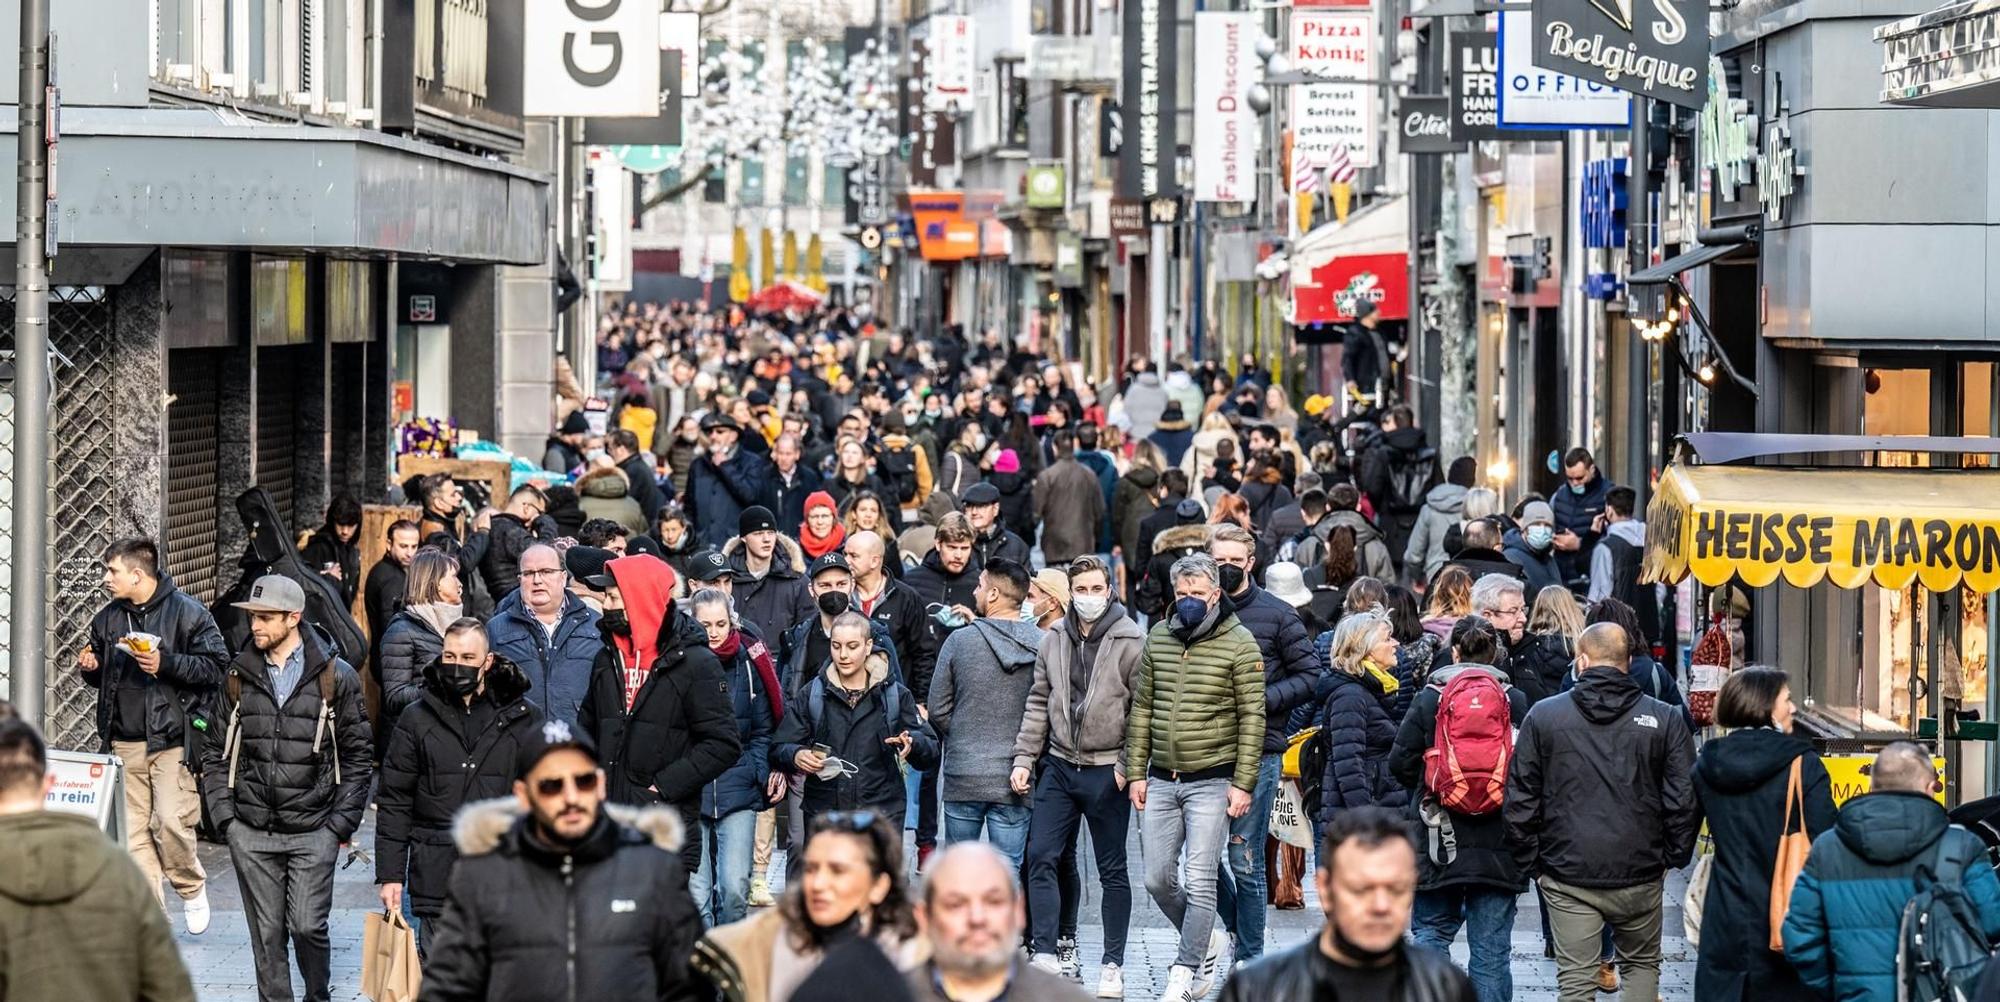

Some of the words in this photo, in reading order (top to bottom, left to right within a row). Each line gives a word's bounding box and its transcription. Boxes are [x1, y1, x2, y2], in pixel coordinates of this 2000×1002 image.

[1302, 21, 1361, 37] Pizza
[1298, 45, 1366, 63] König
[1546, 21, 1698, 91] Belgique
[1217, 23, 1239, 112] Discount
[1513, 75, 1622, 92] OFFIC
[1307, 108, 1357, 117] Softeis
[1299, 125, 1363, 136] gekühlte
[1297, 142, 1365, 152] Getrke
[1216, 121, 1237, 200] Fashion
[1696, 510, 1834, 564] HEISSE
[1851, 517, 2000, 573] MARON
[61, 790, 96, 804] rein!
[1833, 783, 1872, 799] MA
